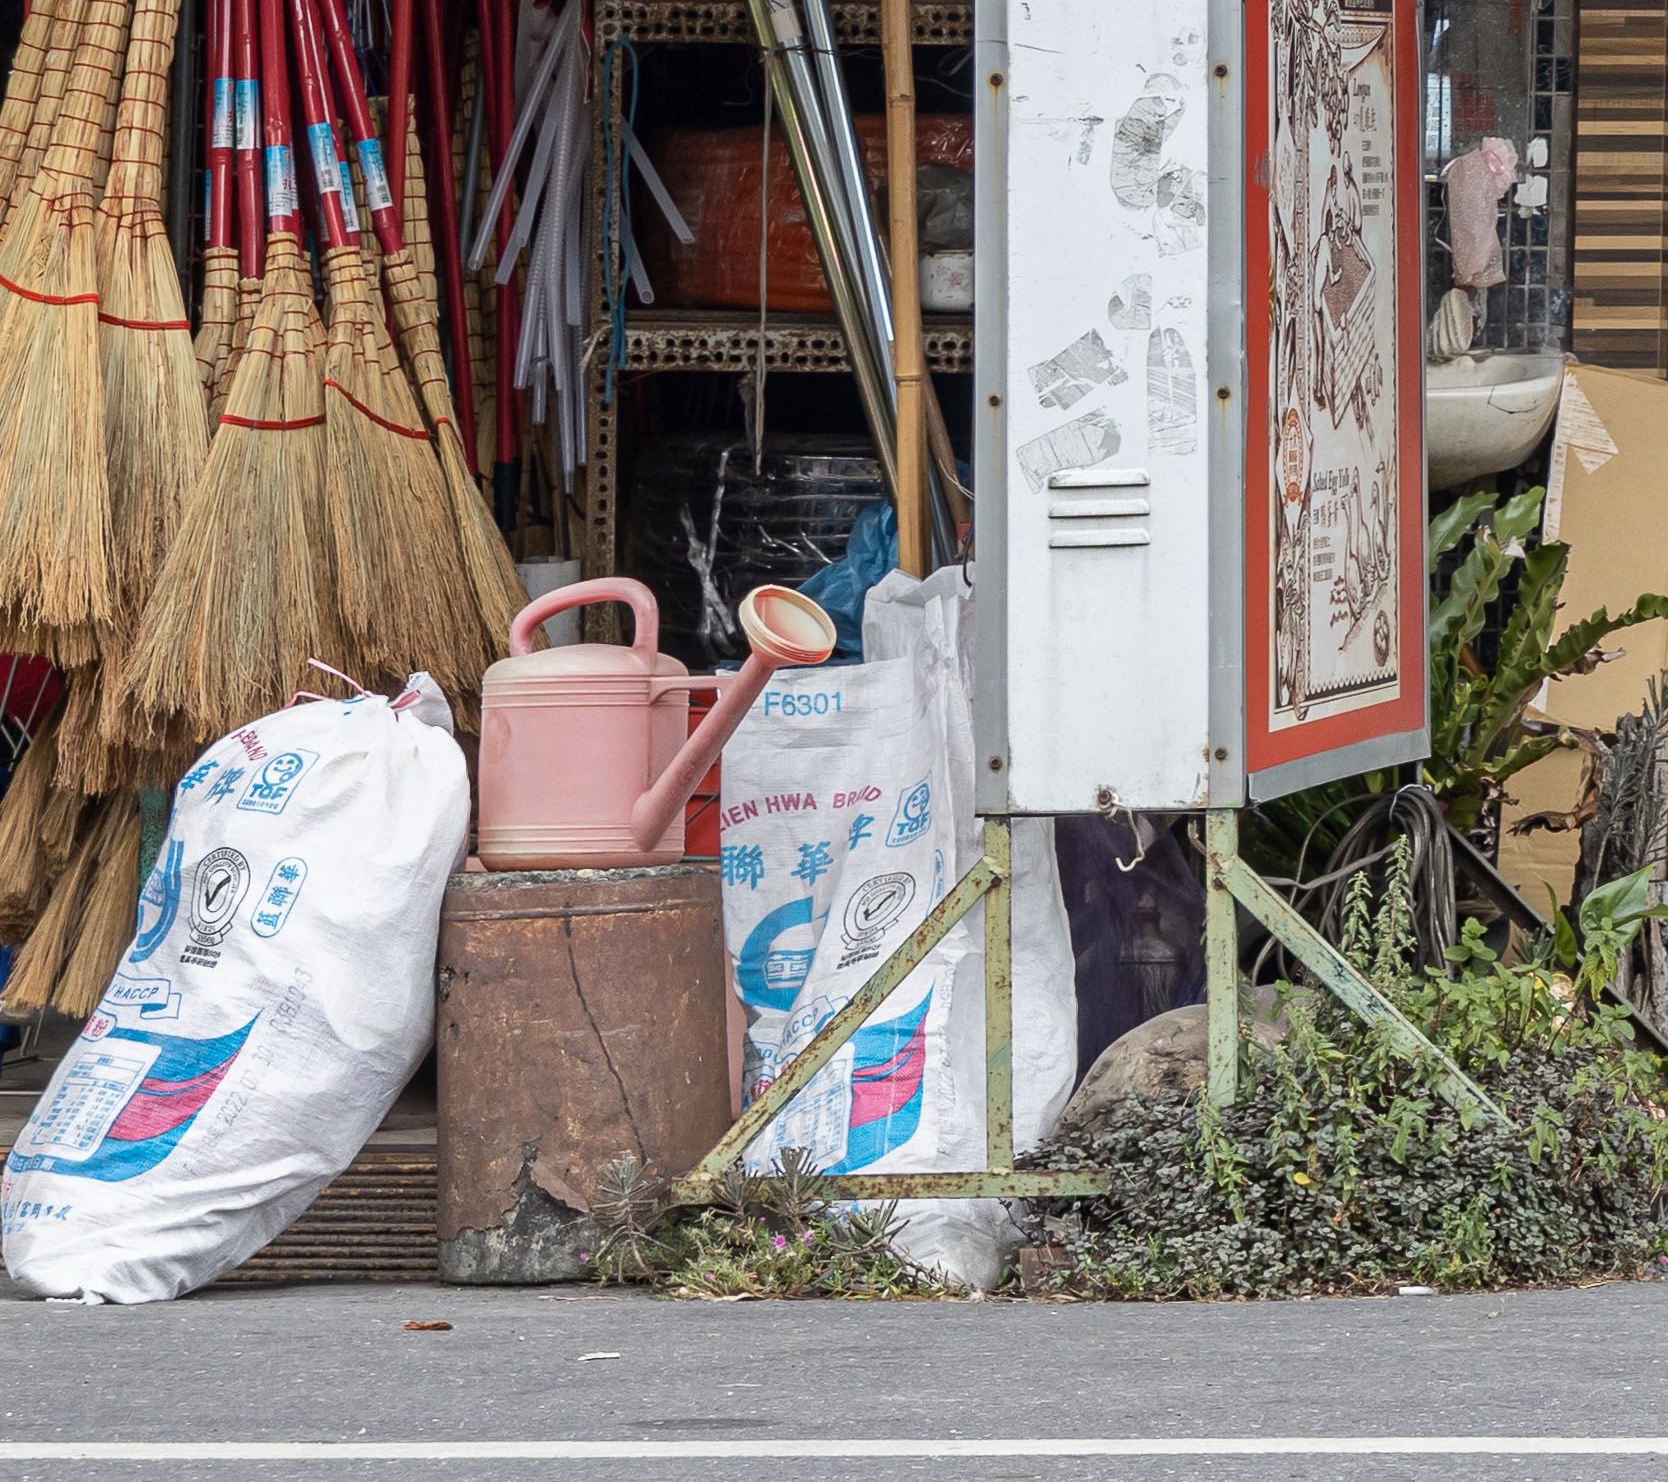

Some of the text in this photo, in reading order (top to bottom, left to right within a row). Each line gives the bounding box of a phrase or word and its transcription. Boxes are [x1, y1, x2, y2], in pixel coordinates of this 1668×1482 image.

[763, 690, 842, 716] F6301
[764, 791, 818, 812] HWA
[113, 986, 160, 1000] HACCP
